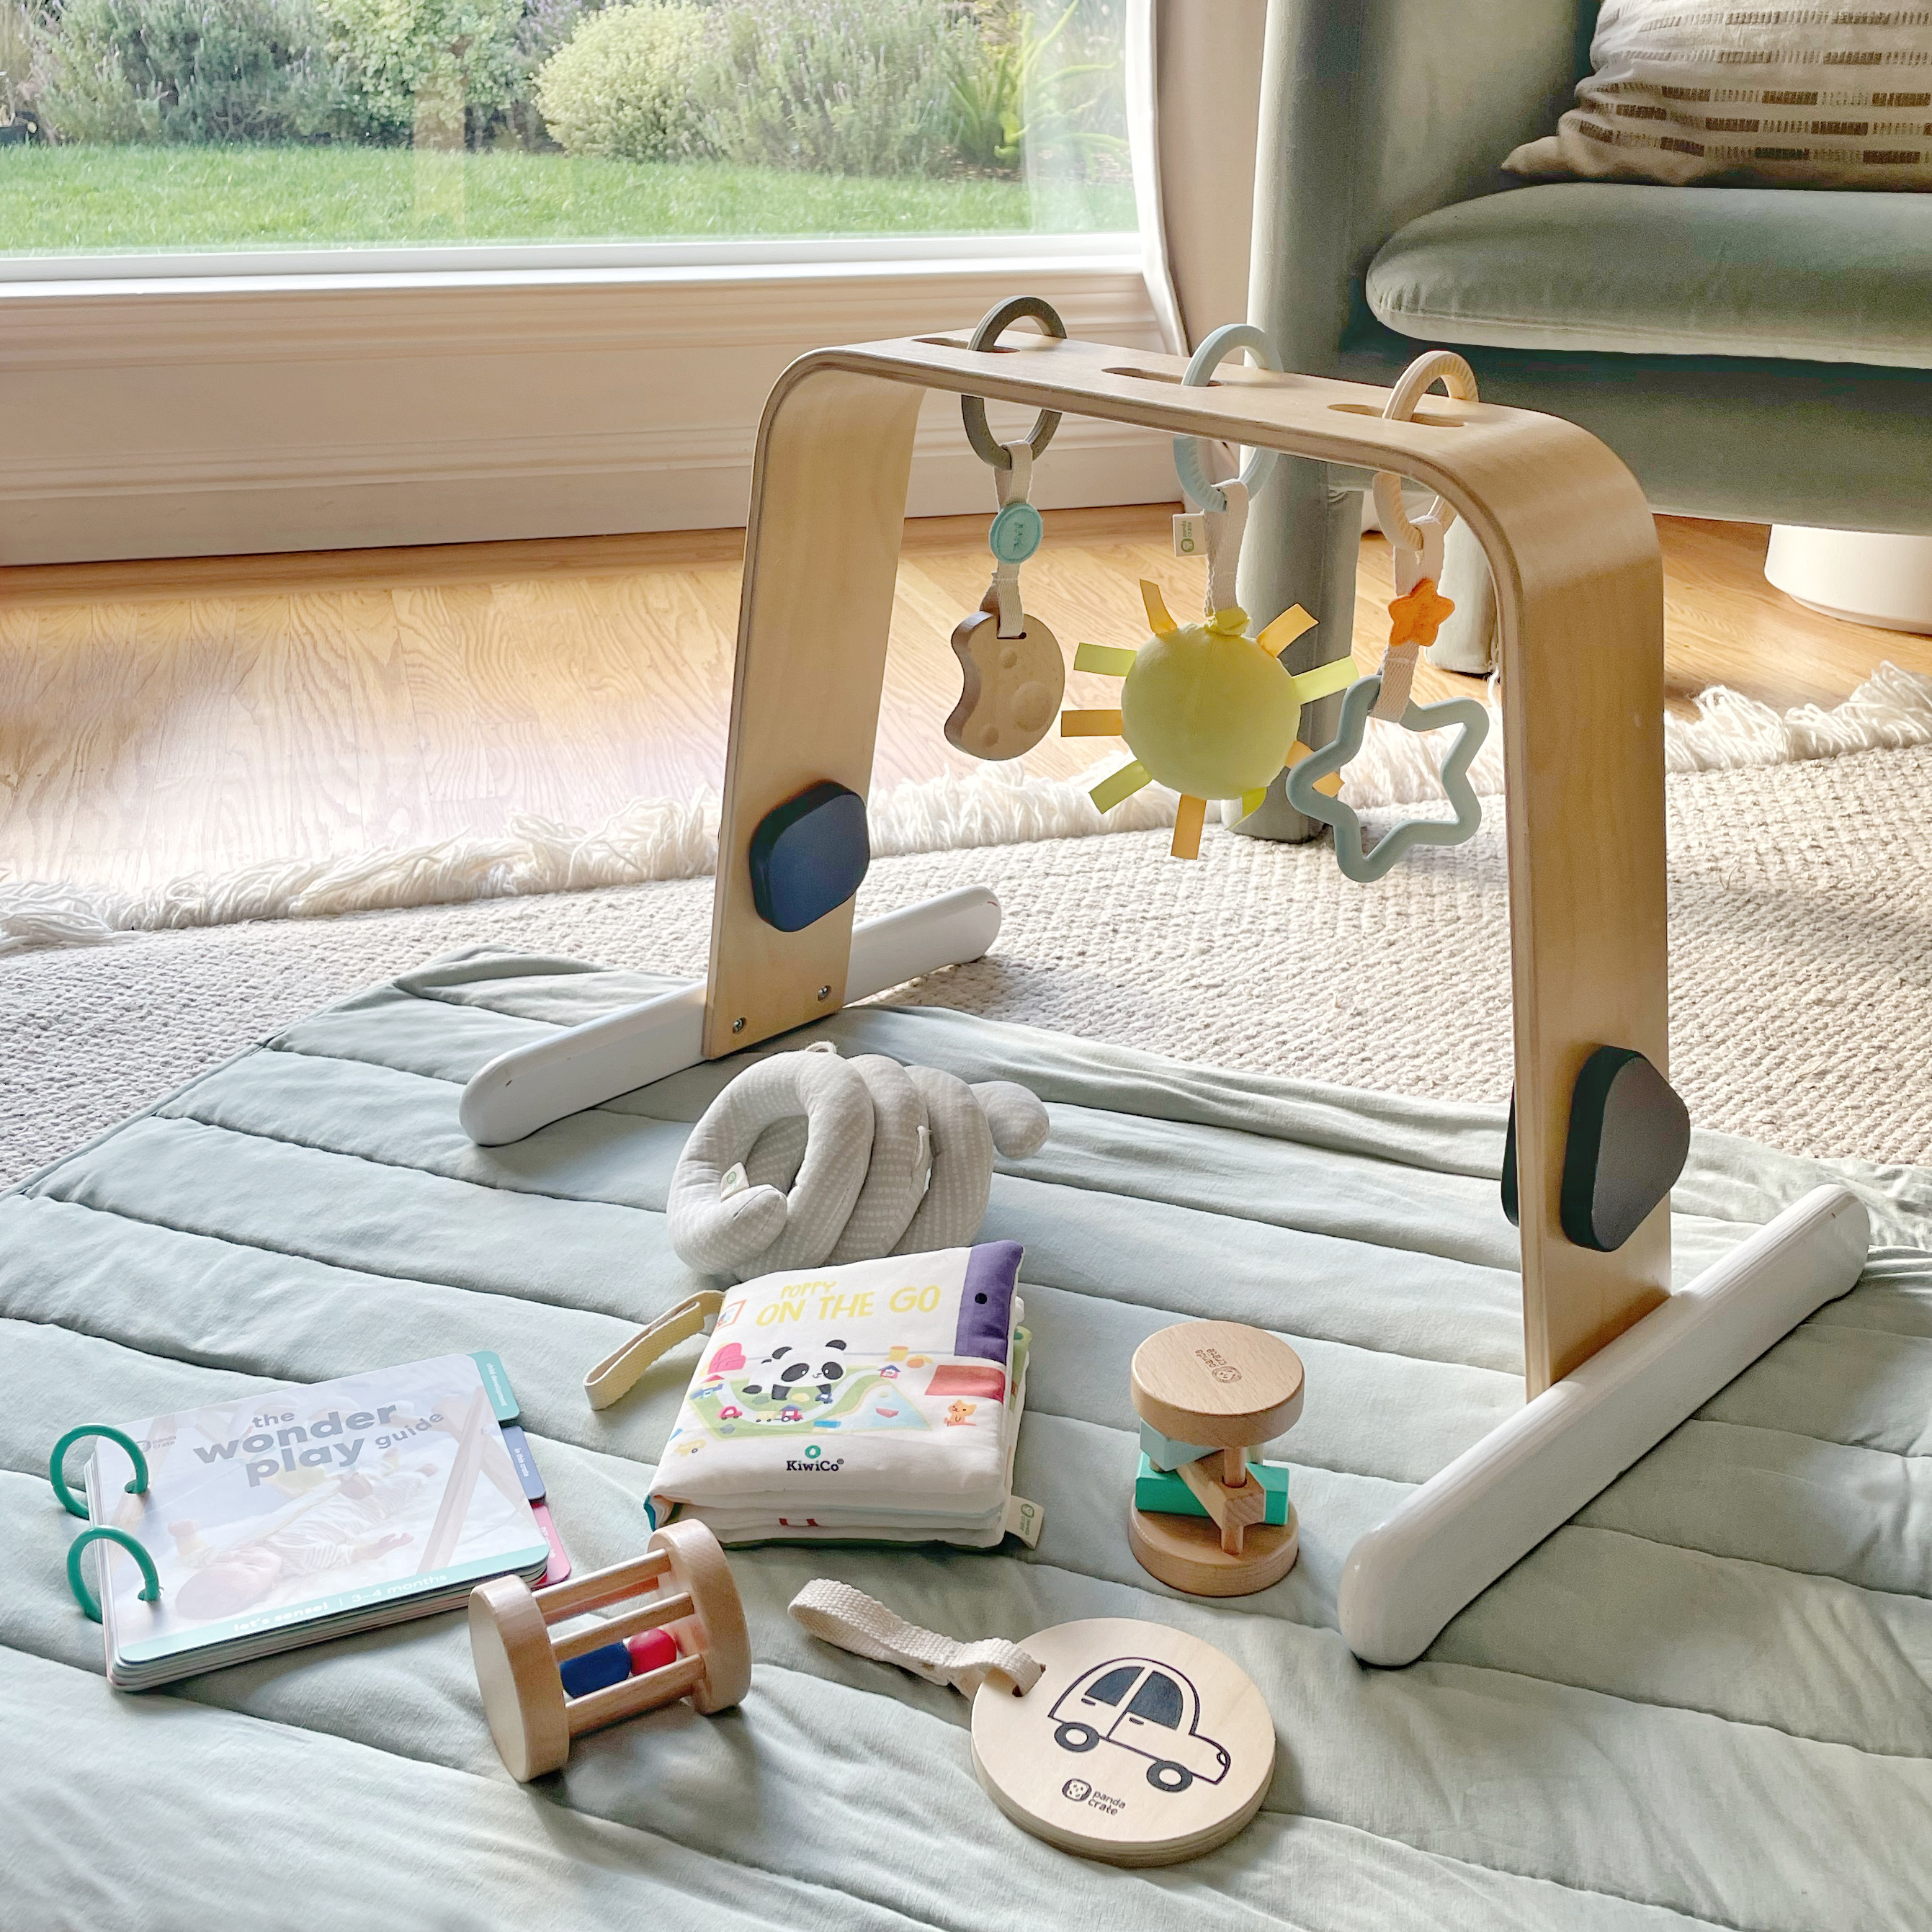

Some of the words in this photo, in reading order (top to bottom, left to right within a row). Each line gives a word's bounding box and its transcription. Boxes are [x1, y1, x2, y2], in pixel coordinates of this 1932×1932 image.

[756, 1298, 806, 1326] ON
[818, 1291, 875, 1320] THE
[889, 1284, 942, 1314] GO
[780, 1281, 837, 1300] POPPY
[193, 1405, 397, 1464] wonder
[253, 1412, 295, 1428] the
[246, 1438, 365, 1488] play
[375, 1413, 444, 1449] guide
[234, 1617, 270, 1632] let's
[387, 1573, 447, 1594] months
[1088, 1799, 1118, 1816] crate
[1092, 1791, 1126, 1809] panda
